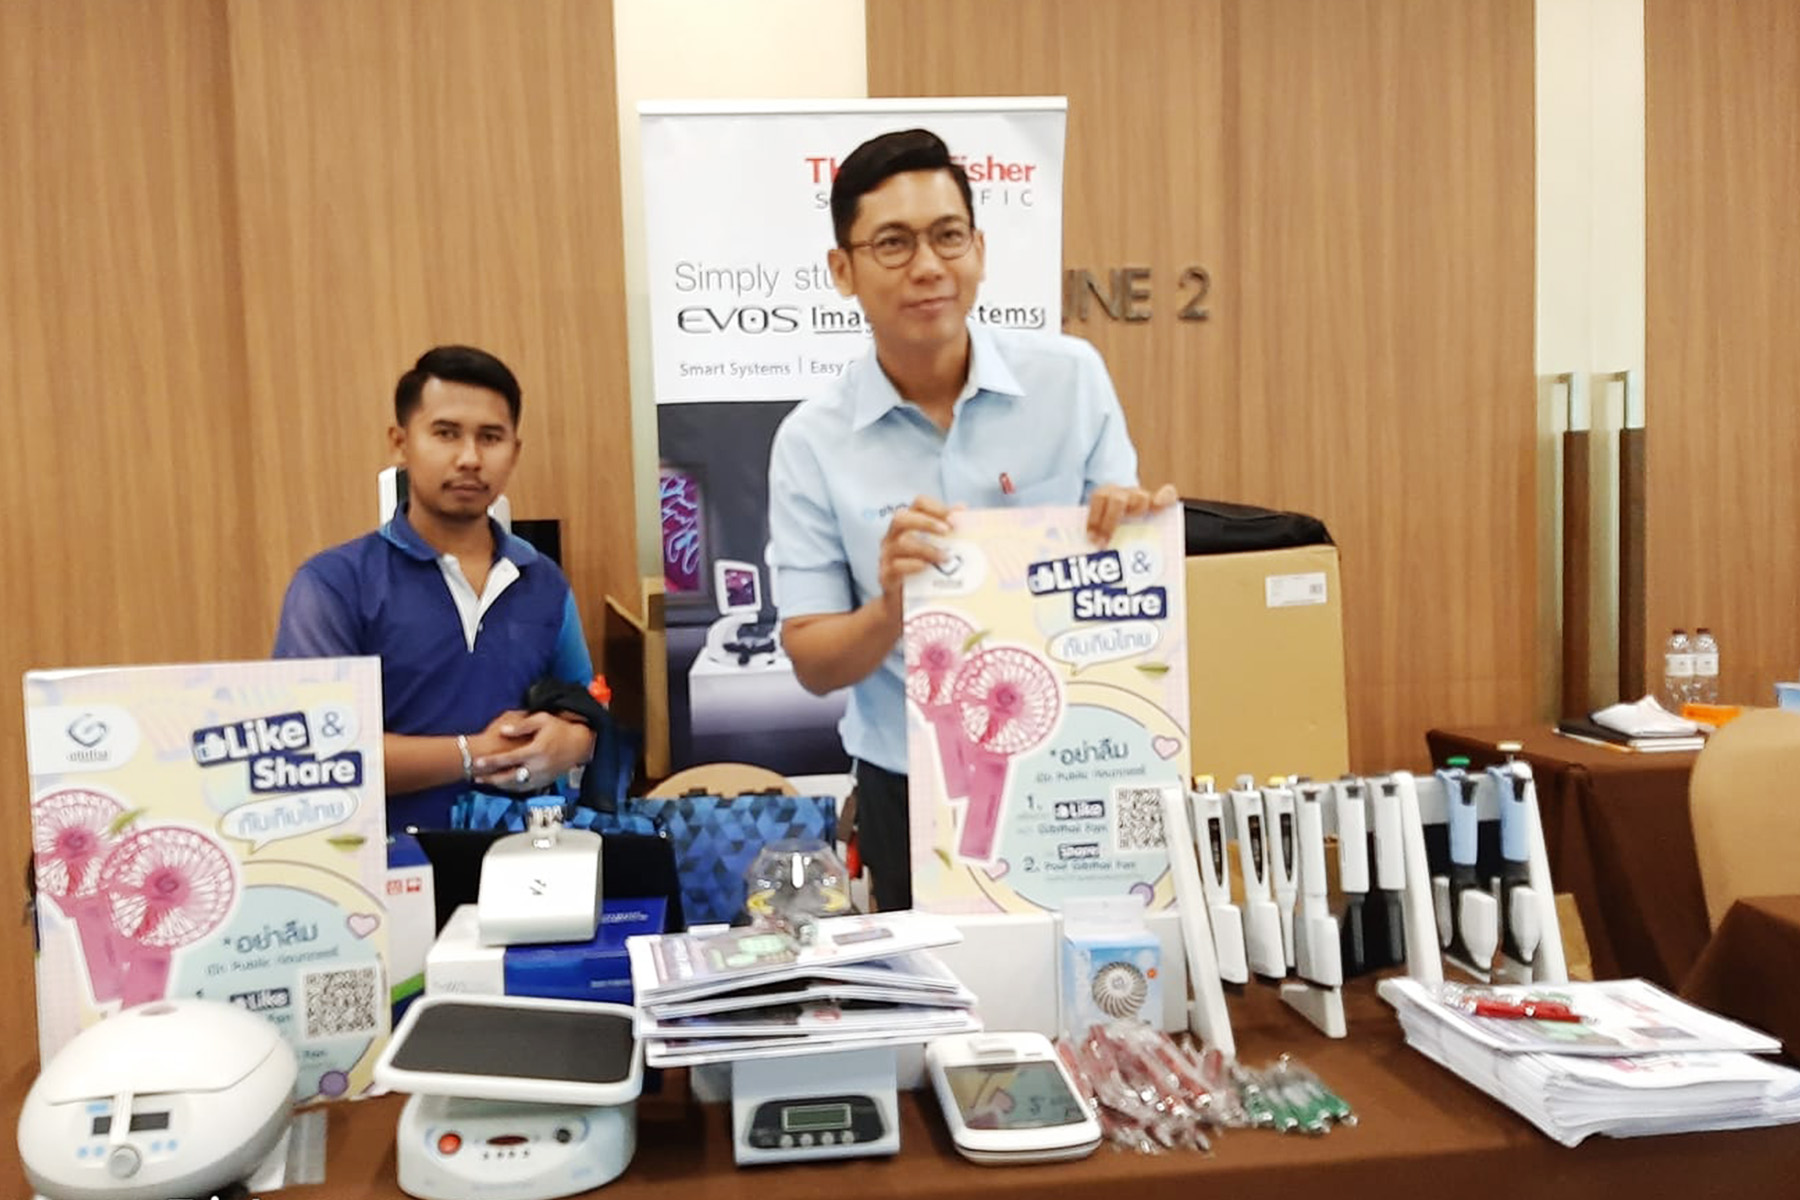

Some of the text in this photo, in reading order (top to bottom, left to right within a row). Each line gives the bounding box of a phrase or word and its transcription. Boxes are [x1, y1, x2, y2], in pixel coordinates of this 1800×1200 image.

[675, 261, 780, 298] Simply
[1062, 266, 1210, 322] INE 2
[677, 305, 800, 335] EVOS
[679, 361, 726, 377] Smart
[730, 360, 792, 379] Systems
[810, 359, 844, 377] Easy
[1053, 550, 1151, 590] Like &
[1075, 589, 1161, 619] Share
[224, 711, 344, 759] Like &
[253, 757, 356, 790] Share
